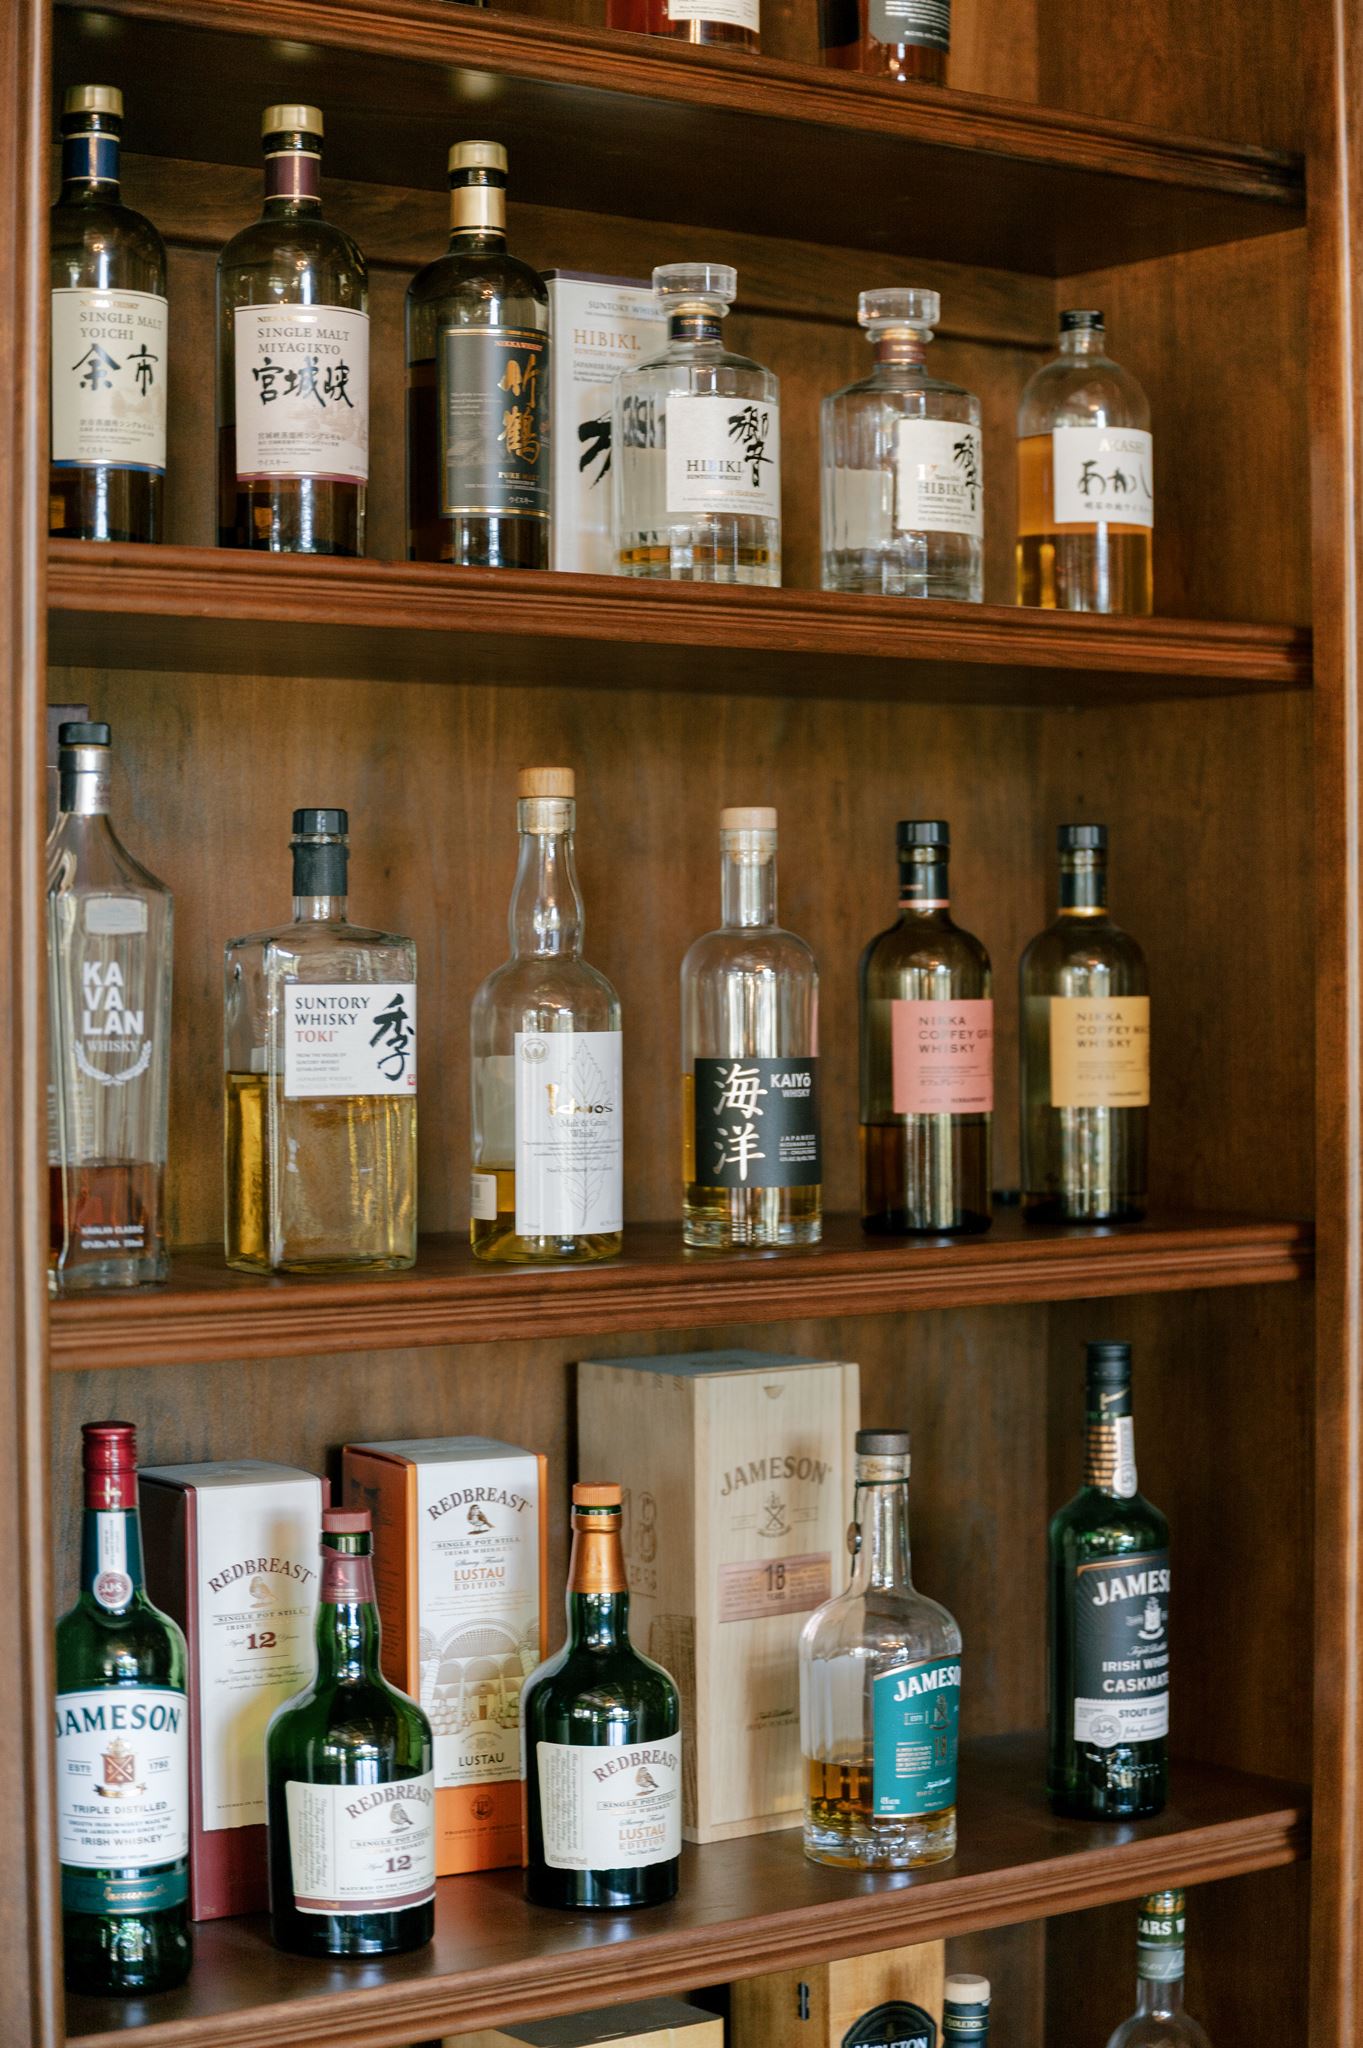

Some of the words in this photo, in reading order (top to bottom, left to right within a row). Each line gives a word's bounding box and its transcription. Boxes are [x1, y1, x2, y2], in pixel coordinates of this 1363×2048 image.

[80, 311, 134, 325] SINGLE
[137, 315, 162, 330] MALT
[80, 327, 134, 340] YOICHI
[257, 327, 312, 338] SINGLE
[316, 328, 350, 341] MALT
[574, 329, 637, 349] HIBIKI
[257, 342, 341, 356] MIYAGIKYO
[72, 343, 160, 397] 余市
[252, 356, 354, 408] 宮城峡
[295, 997, 371, 1010] SUNTORY
[295, 1014, 358, 1026] WHISKY
[88, 1040, 138, 1052] WHISKY
[919, 1044, 975, 1053] WHISKY
[782, 1088, 811, 1098] WHISKY
[713, 1063, 769, 1181] 海洋
[721, 1455, 828, 1496] JAMESON
[427, 1486, 529, 1521] REDBREAST
[207, 1556, 312, 1595] REDBREAST
[454, 1566, 506, 1581] LUSTAU
[764, 1564, 787, 1592] 18
[454, 1581, 506, 1591] EDITION
[218, 1613, 253, 1622] SINGLE
[278, 1607, 305, 1616] STILL
[247, 1631, 277, 1650] 12
[1102, 1660, 1141, 1672] IRISH
[1118, 1708, 1147, 1718] STOUT
[458, 1752, 505, 1767] LUSTAU
[592, 1749, 678, 1782] REDBREAST
[72, 1804, 110, 1815] TRIPLE
[114, 1801, 168, 1815] DISTILLED
[603, 1800, 638, 1808] SINGLE
[619, 1823, 666, 1841] LUSTAU
[81, 1837, 110, 1846] IRISH
[114, 1834, 163, 1846] WHISKEY
[356, 1839, 392, 1847] SINGLE
[385, 1854, 413, 1874] 12
